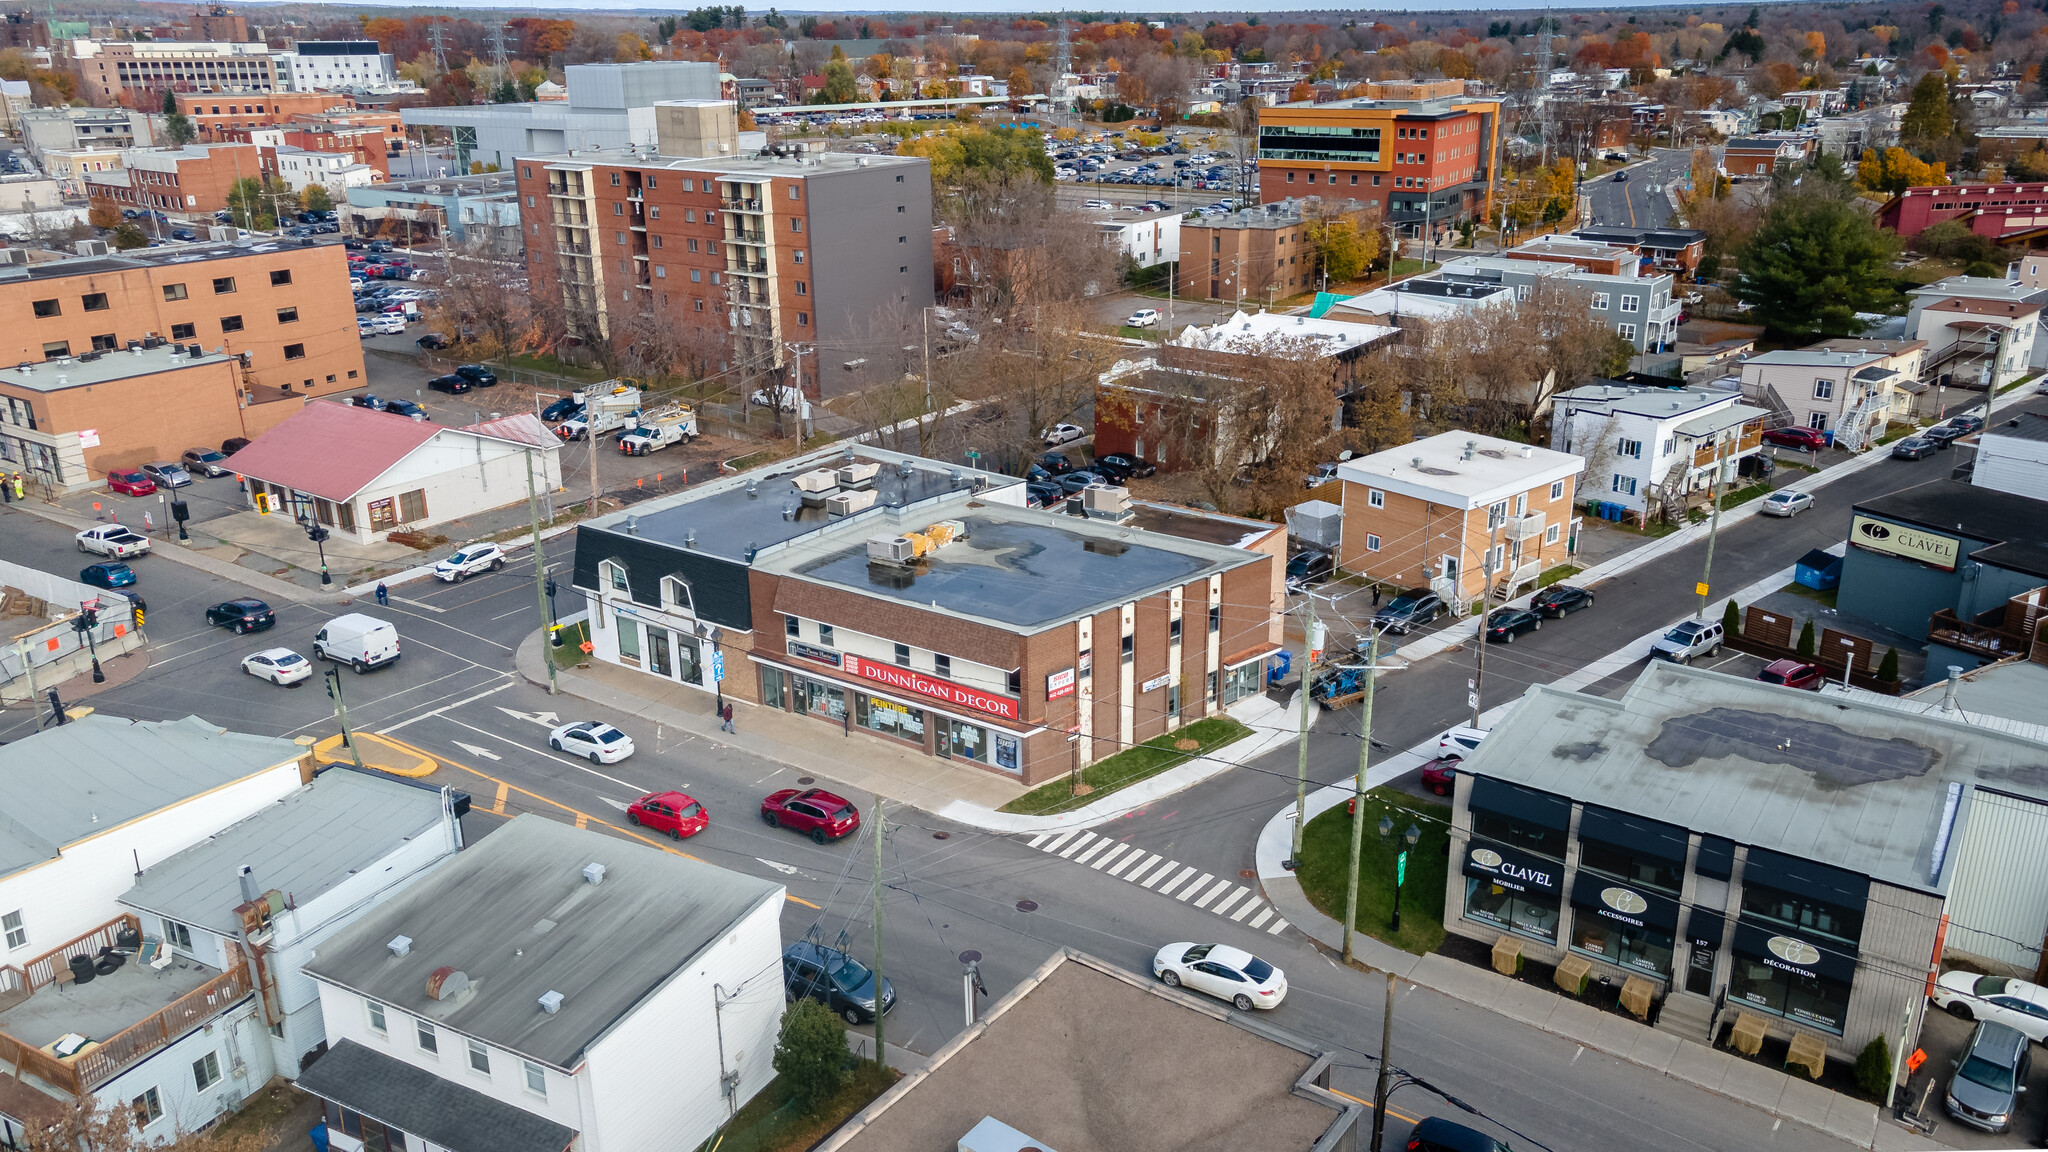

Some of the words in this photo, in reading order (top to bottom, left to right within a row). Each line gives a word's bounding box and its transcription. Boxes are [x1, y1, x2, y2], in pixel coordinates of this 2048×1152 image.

[1898, 534, 1952, 557] CLAVEL
[1050, 676, 1073, 689] EXPERT
[871, 697, 908, 715] PEINTURE
[955, 690, 1011, 717] DECOR
[1501, 863, 1552, 887] CLAVEL
[1492, 878, 1525, 892] MOBILIER
[1597, 909, 1644, 927] ACCESSOIRES
[1696, 938, 1709, 947] 157
[1763, 957, 1817, 979] DÉCORATION
[1794, 1007, 1836, 1024] CONSULTATION
